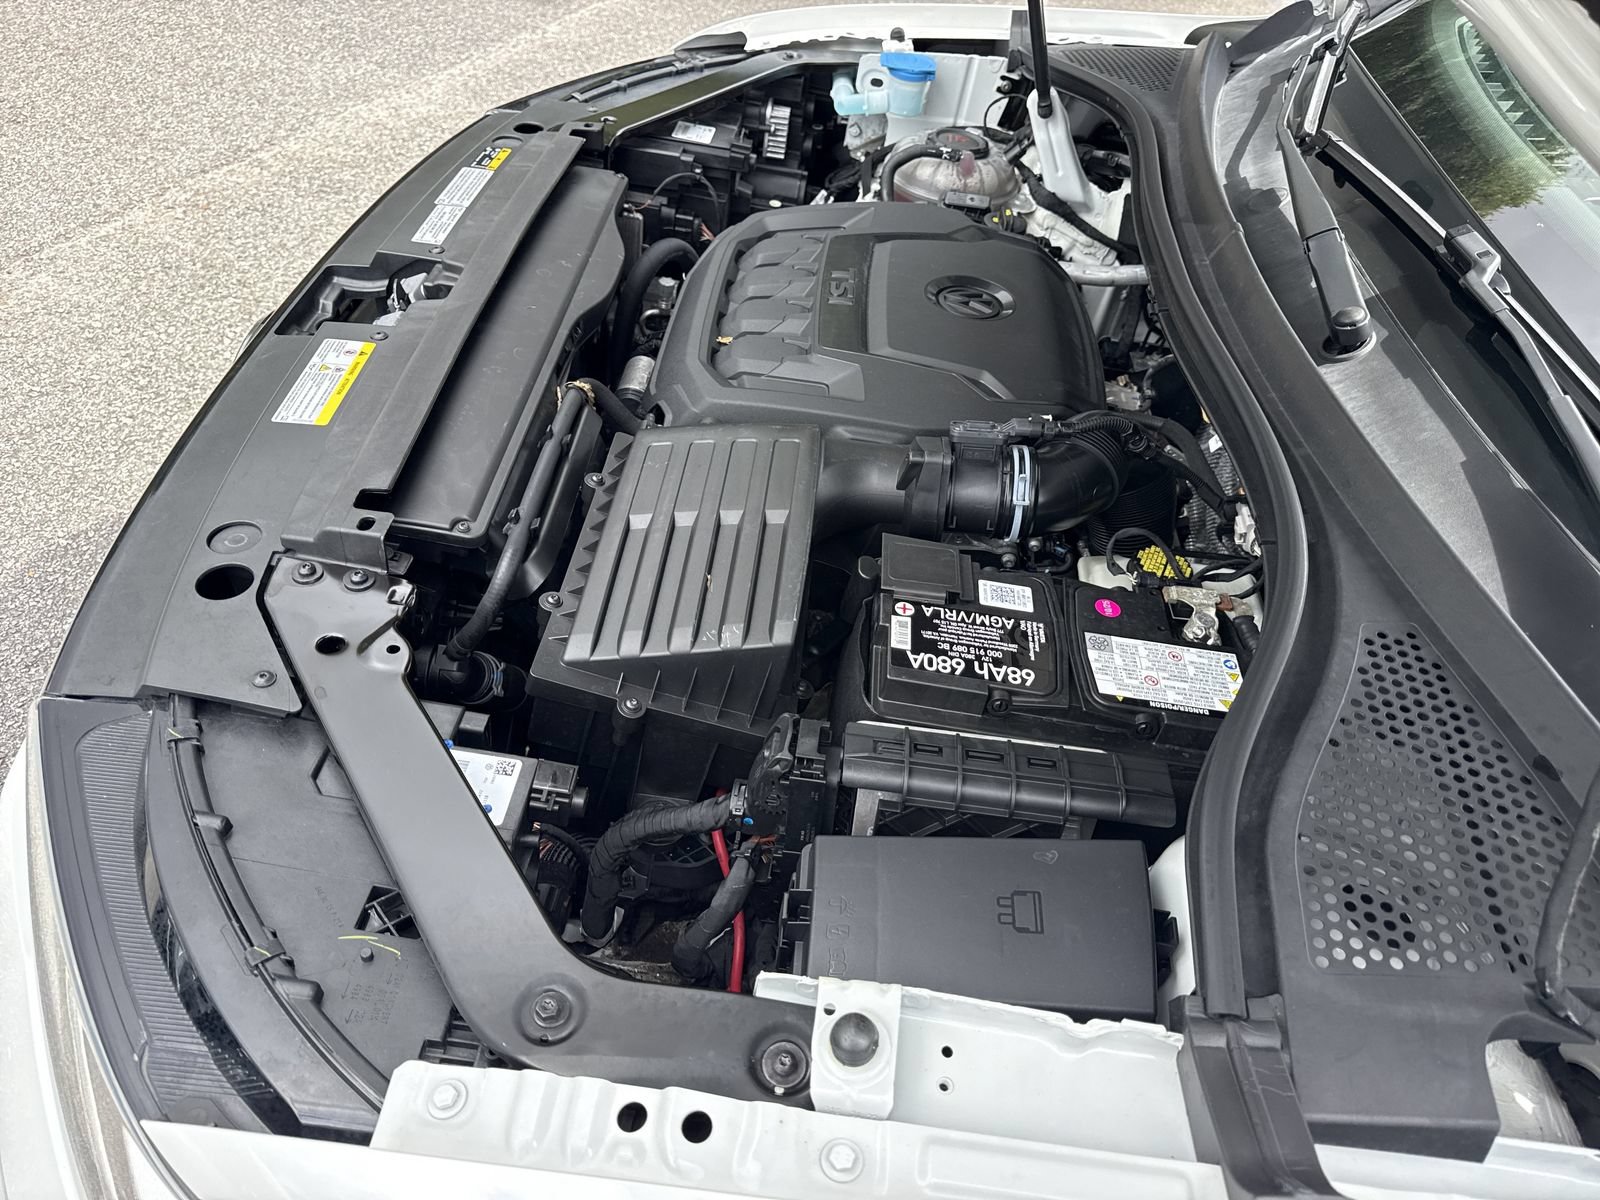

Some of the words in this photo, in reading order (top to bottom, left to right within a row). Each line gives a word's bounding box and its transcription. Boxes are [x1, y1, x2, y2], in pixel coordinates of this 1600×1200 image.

[828, 268, 858, 306] TSI
[921, 605, 1014, 630] AGM/VRLA
[937, 642, 950, 650] BC
[952, 644, 968, 653] 089
[969, 647, 985, 656] 915
[987, 650, 1002, 658] 000
[906, 650, 965, 675] 680A
[974, 661, 1035, 686] 68Ah
[1150, 701, 1210, 715] DANGER/POISON
